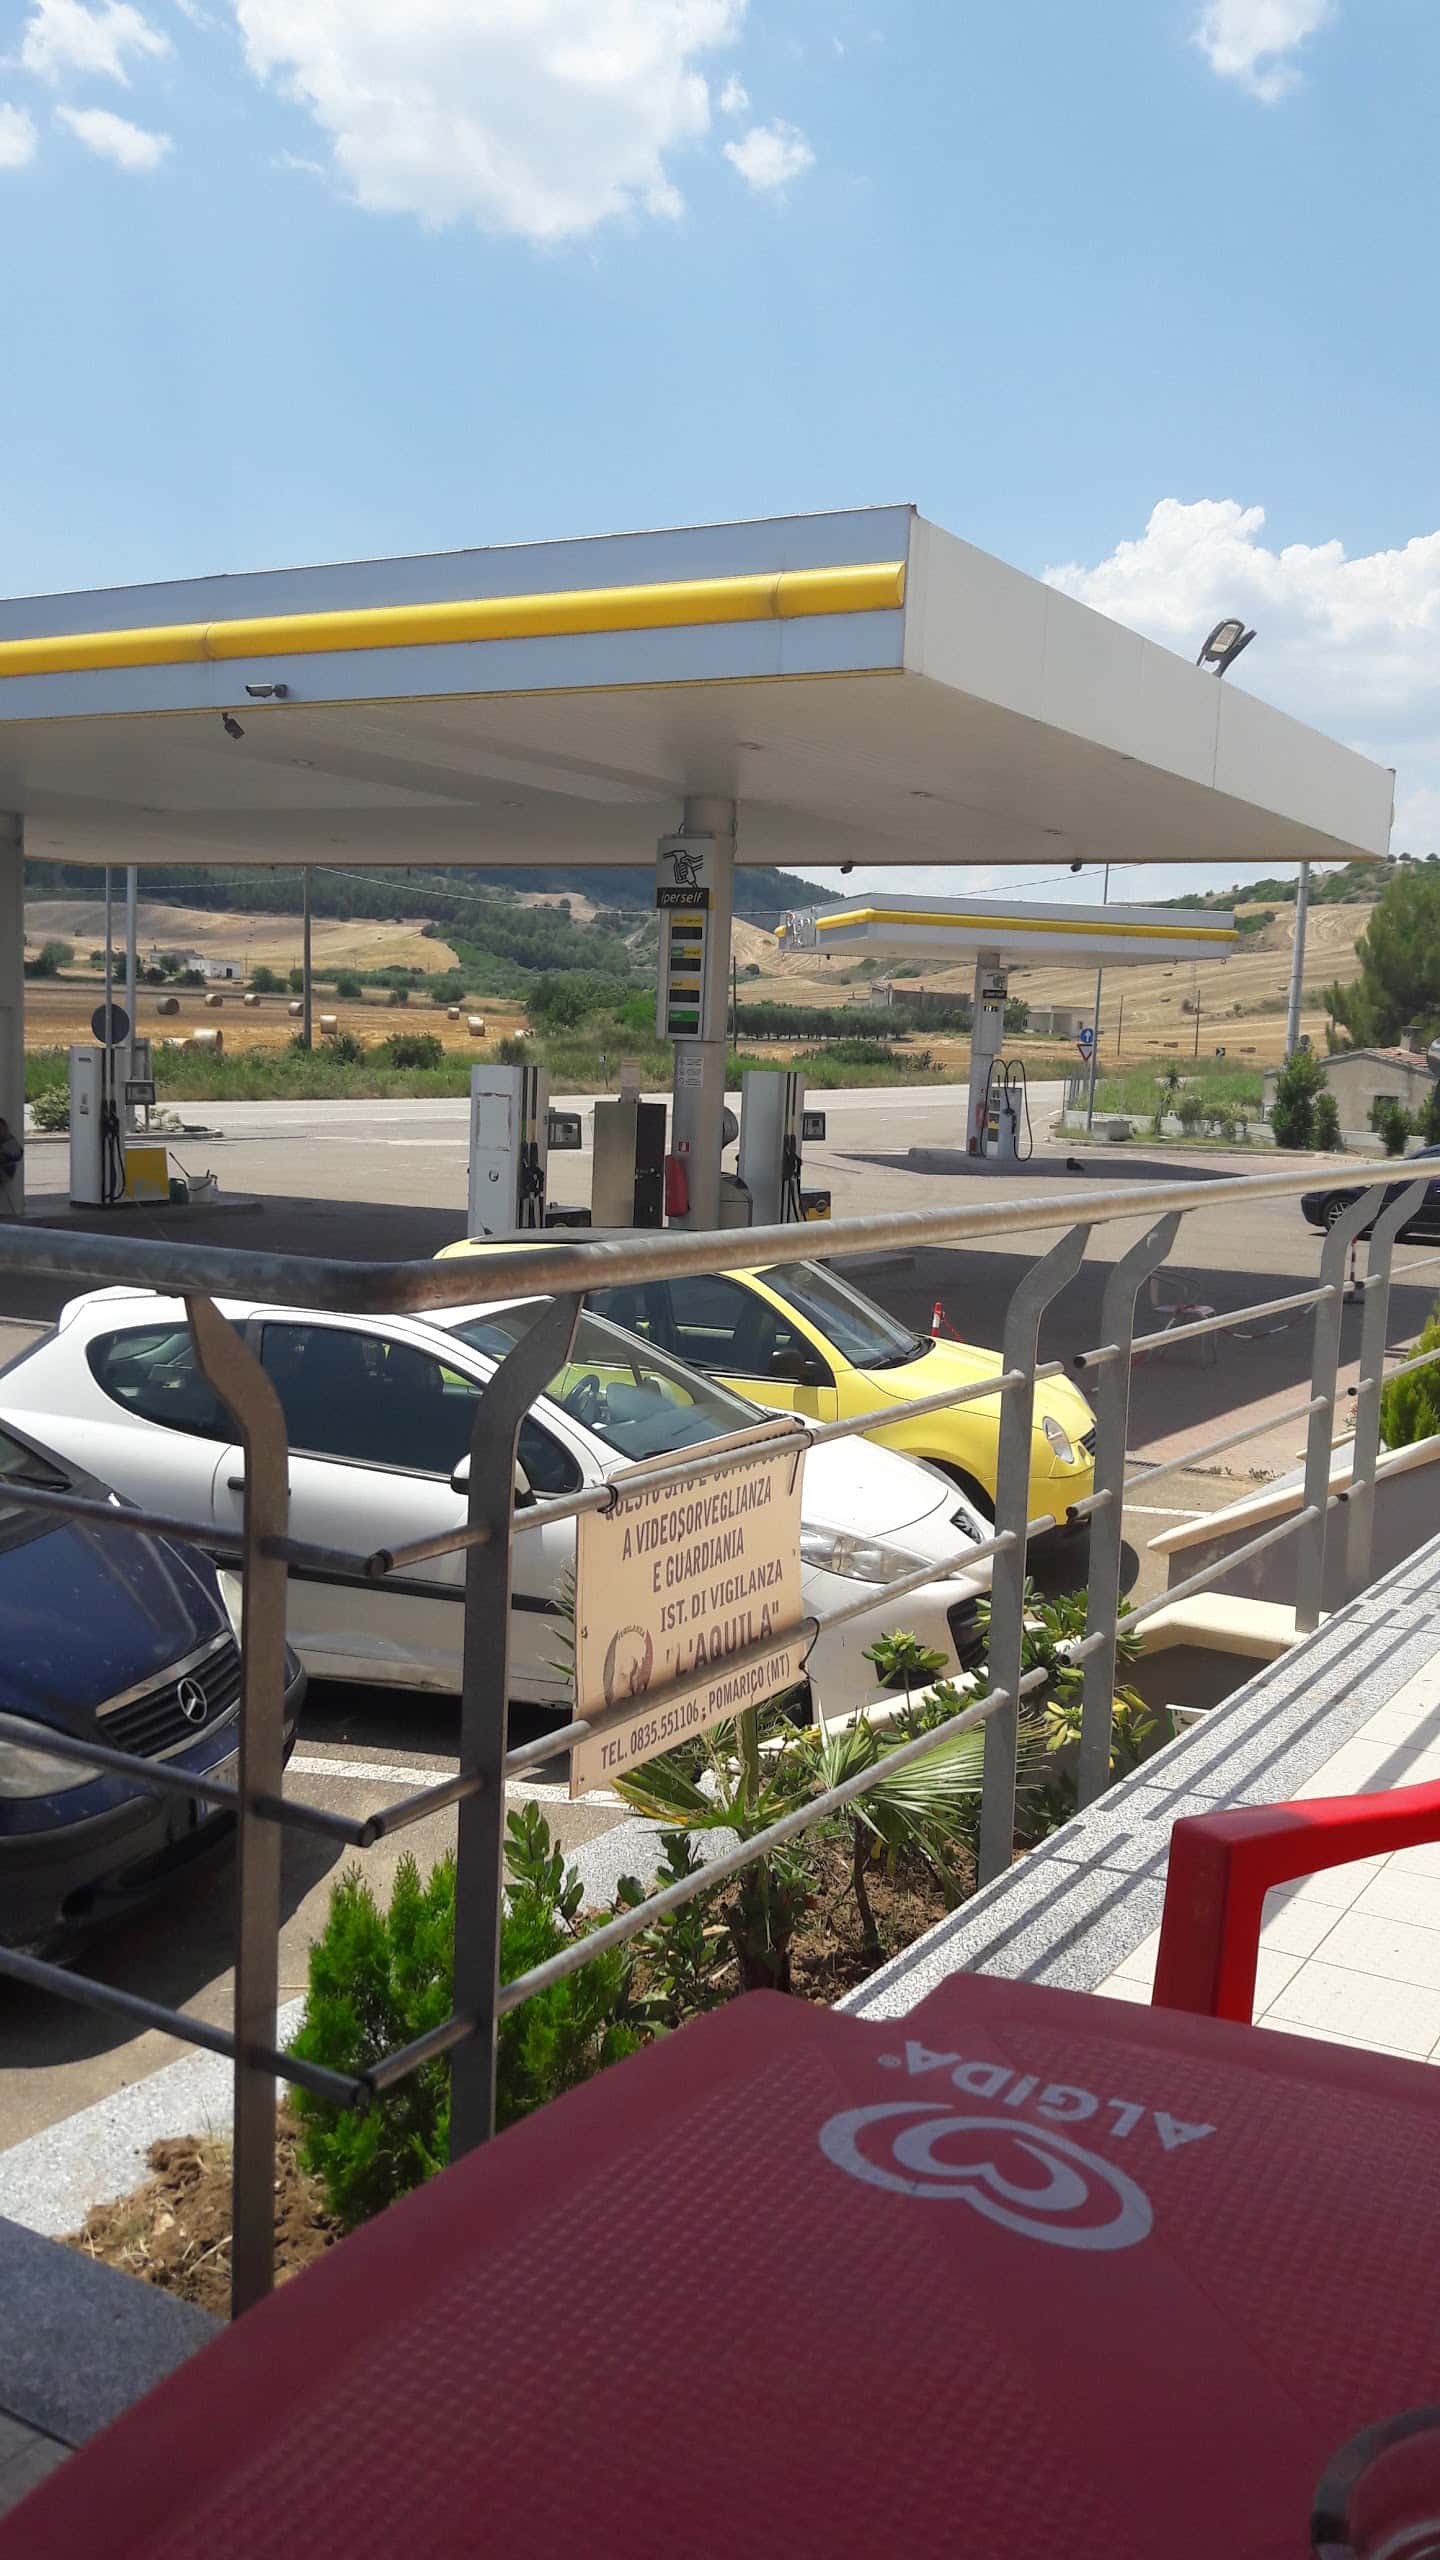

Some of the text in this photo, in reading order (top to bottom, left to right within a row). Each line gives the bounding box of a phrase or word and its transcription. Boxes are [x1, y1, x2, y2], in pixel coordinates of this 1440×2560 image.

[622, 1527, 632, 1561] A
[636, 1476, 772, 1554] VIDEOSORVEGLIANZA
[652, 1527, 745, 1593] E GUARDIANIA
[660, 1559, 783, 1633] IST. DI VIGILANZA
[600, 1738, 628, 1770] TEL.
[630, 1699, 699, 1755] 0835.551106
[709, 1668, 764, 1714] POMARICO
[766, 1652, 791, 1687] (MT)
